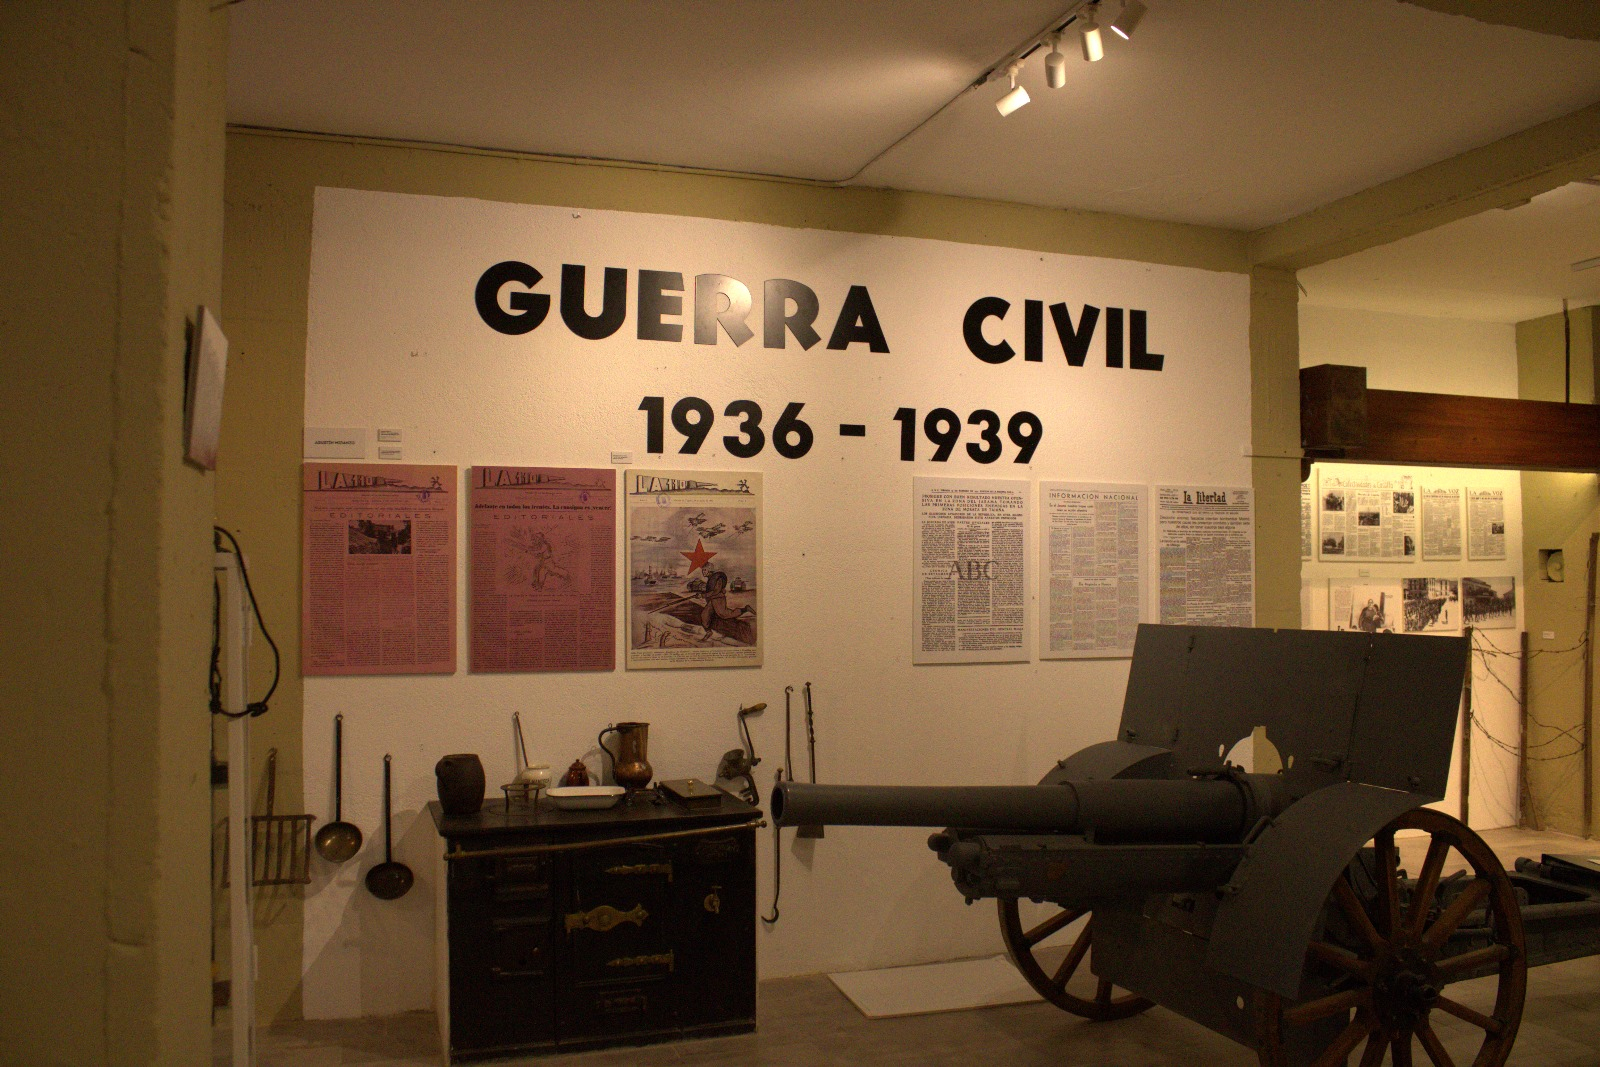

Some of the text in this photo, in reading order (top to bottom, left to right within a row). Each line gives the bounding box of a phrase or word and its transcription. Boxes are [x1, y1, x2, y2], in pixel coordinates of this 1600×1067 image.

[475, 261, 1165, 371] GUERRA CIVIL
[638, 396, 1043, 464] 1936 - 1939
